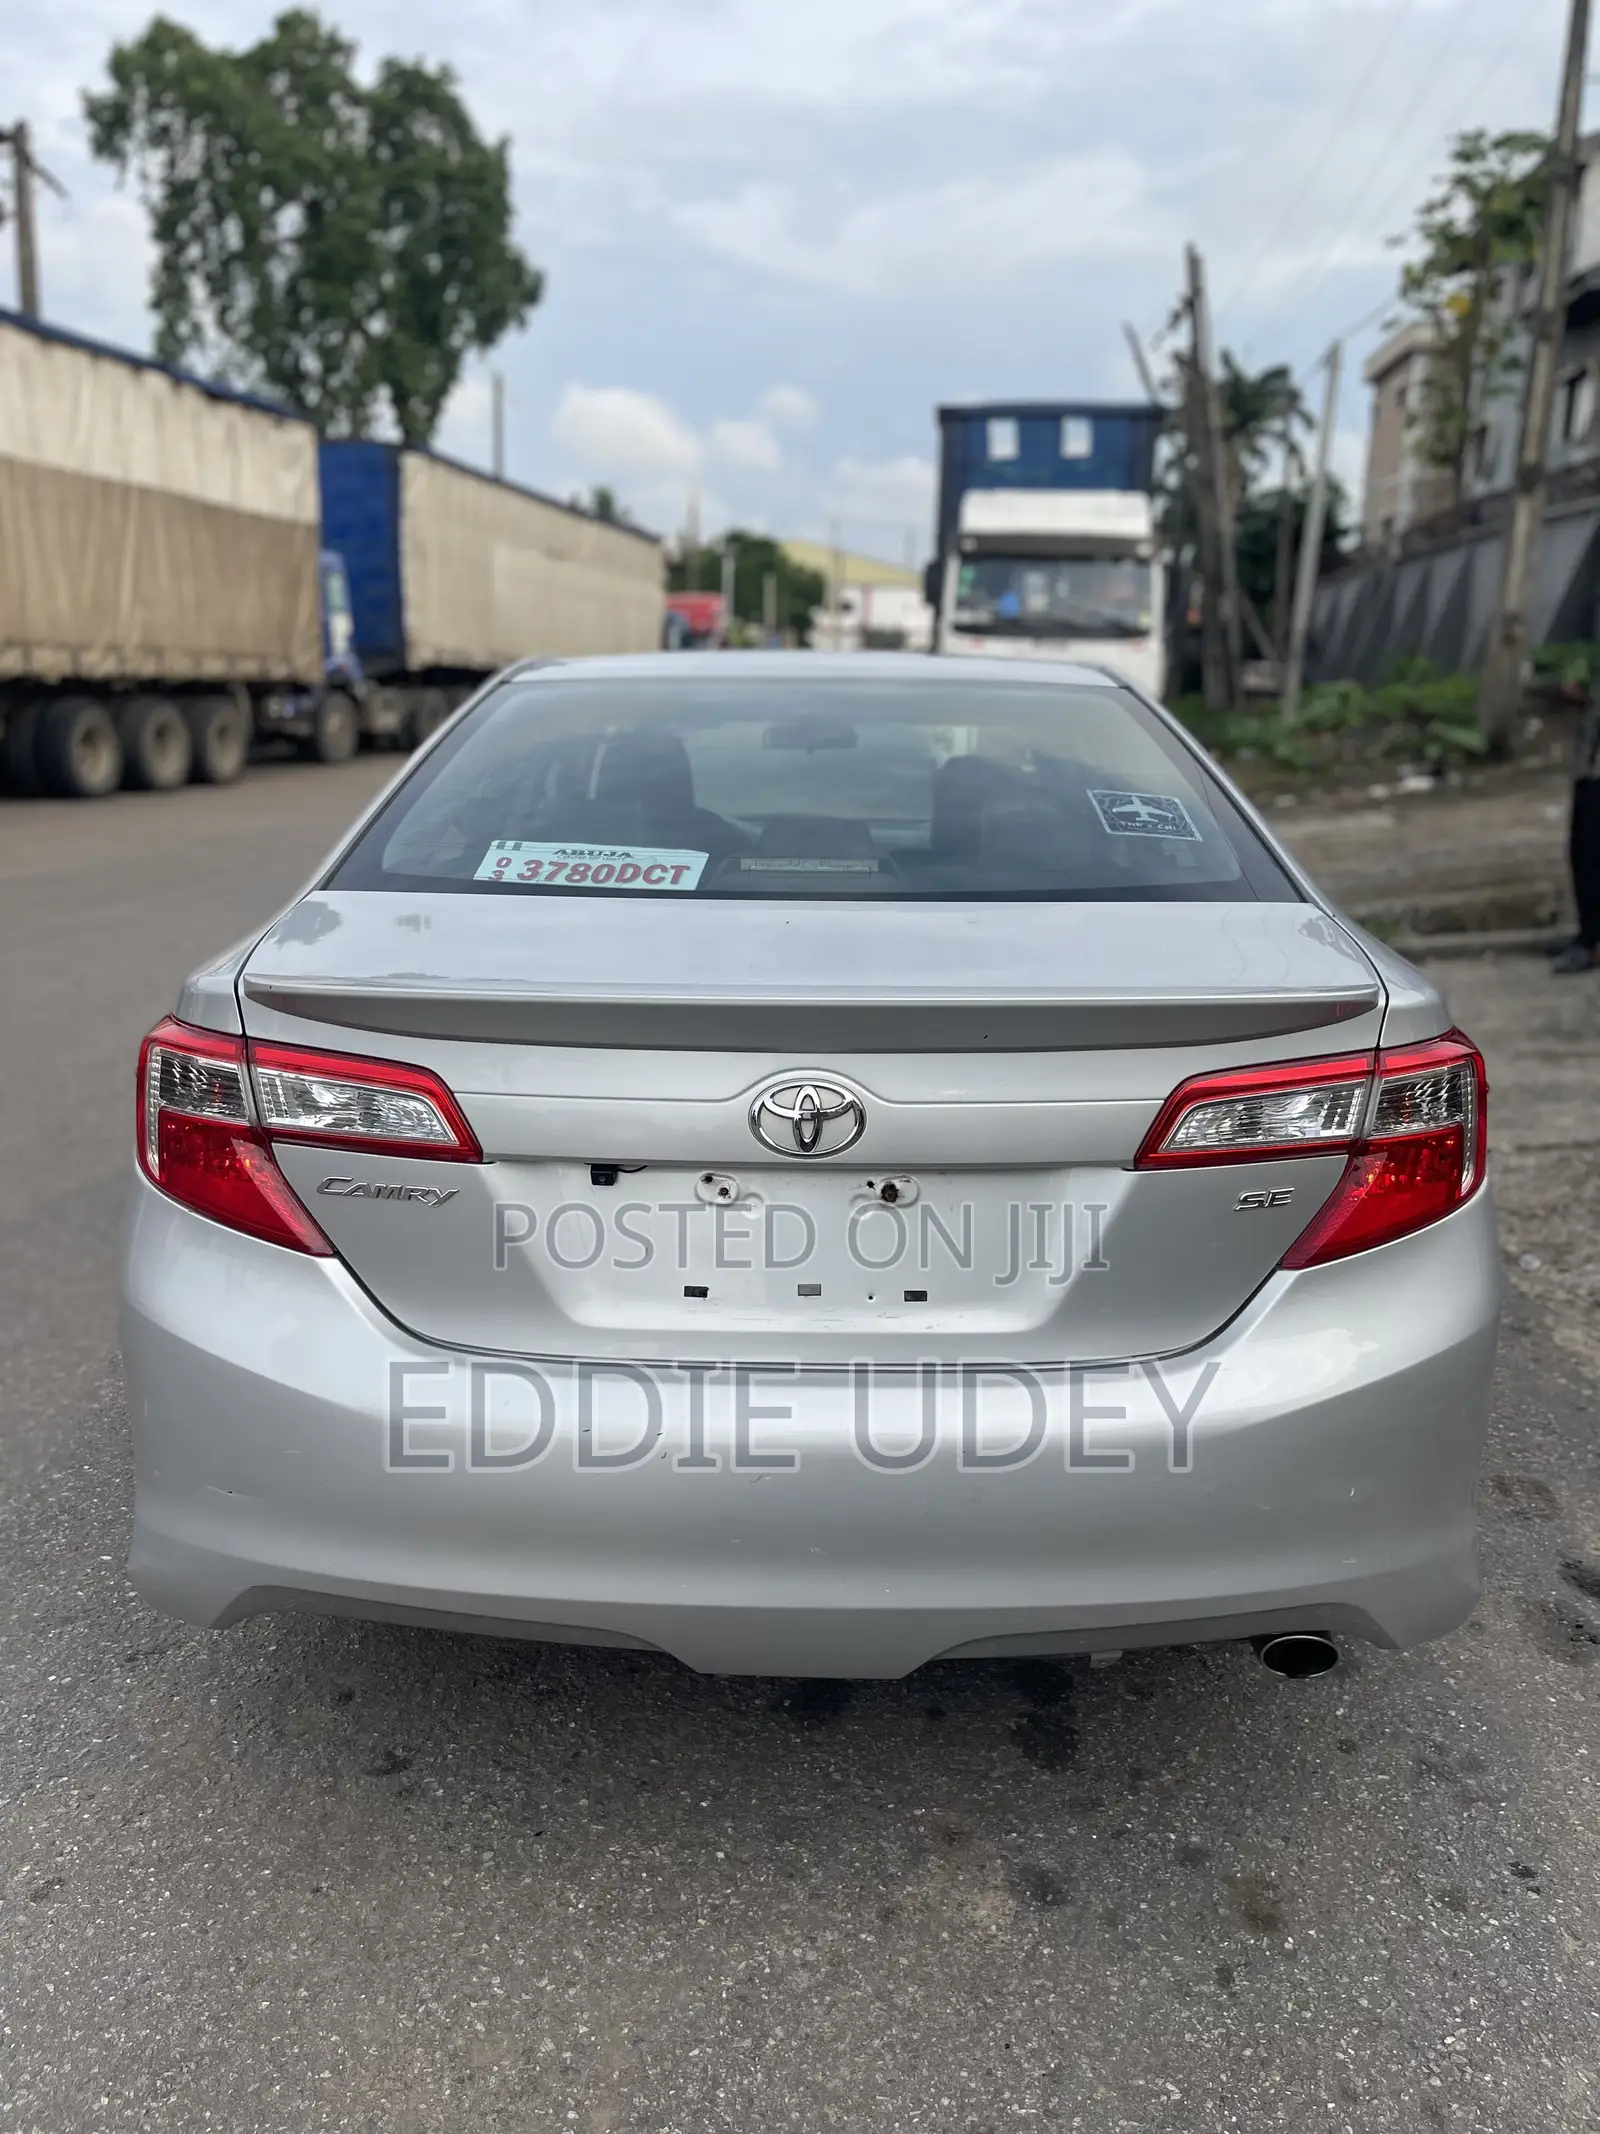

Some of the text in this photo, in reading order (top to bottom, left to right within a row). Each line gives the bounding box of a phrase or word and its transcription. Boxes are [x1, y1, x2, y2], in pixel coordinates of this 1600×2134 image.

[553, 849, 634, 859] ABUJA
[517, 860, 691, 885] 3780DCT
[316, 1175, 460, 1208] CAMRY
[1234, 1186, 1295, 1211] SE
